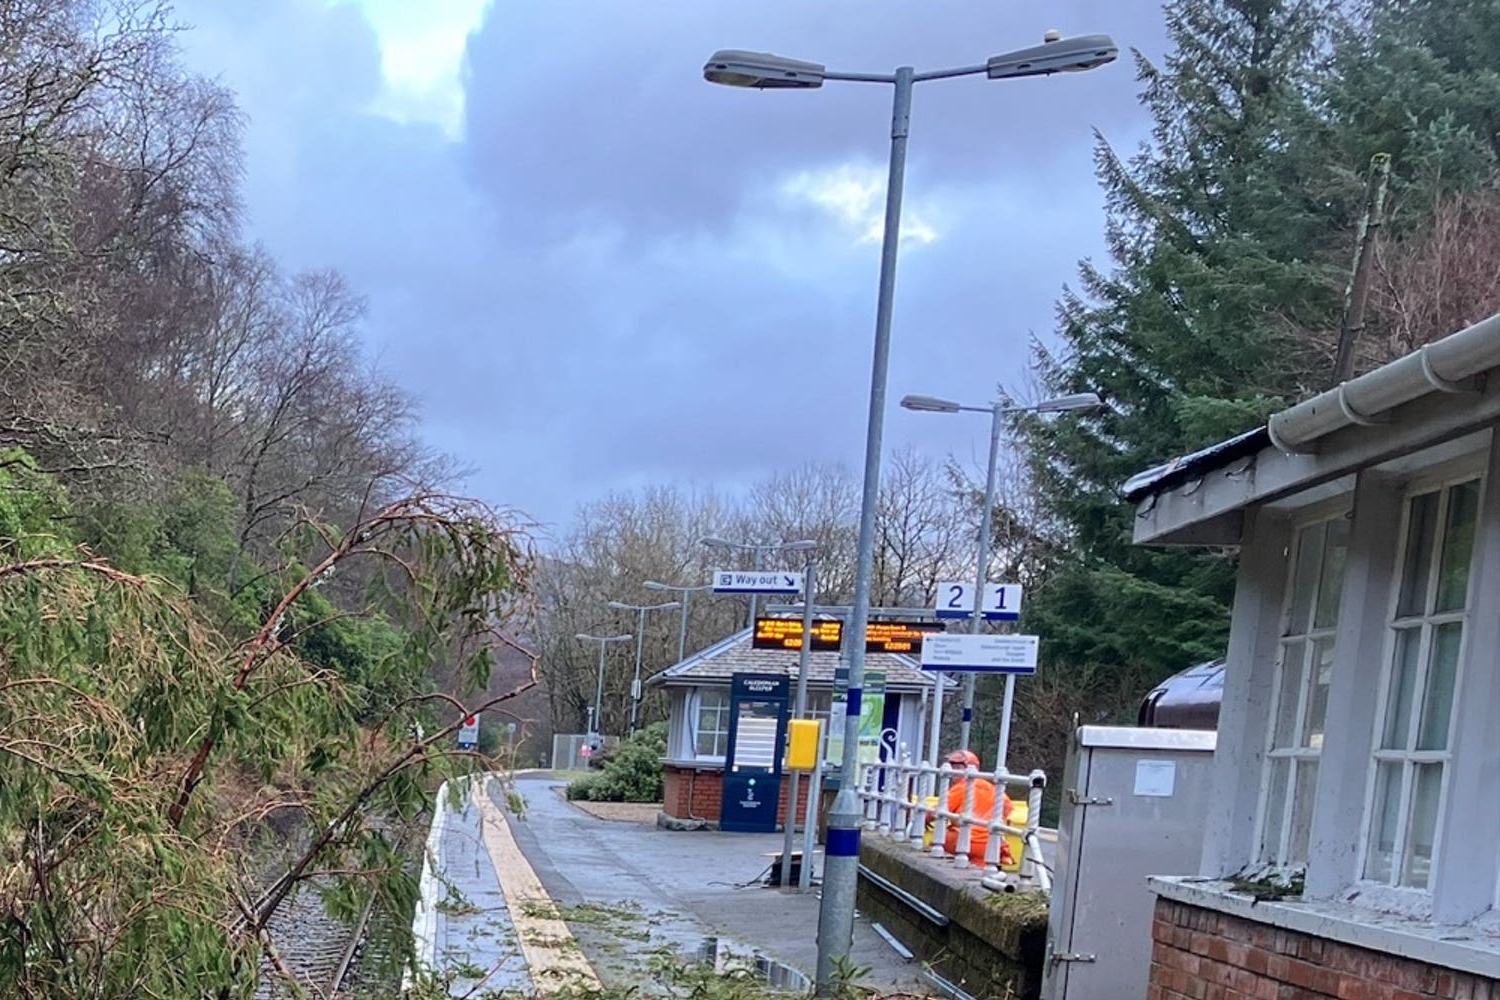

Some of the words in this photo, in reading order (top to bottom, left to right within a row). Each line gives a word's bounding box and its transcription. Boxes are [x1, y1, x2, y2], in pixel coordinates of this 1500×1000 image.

[736, 574, 756, 586] Way
[760, 575, 778, 585] out
[948, 585, 964, 608] 2
[995, 586, 1007, 610] 1
